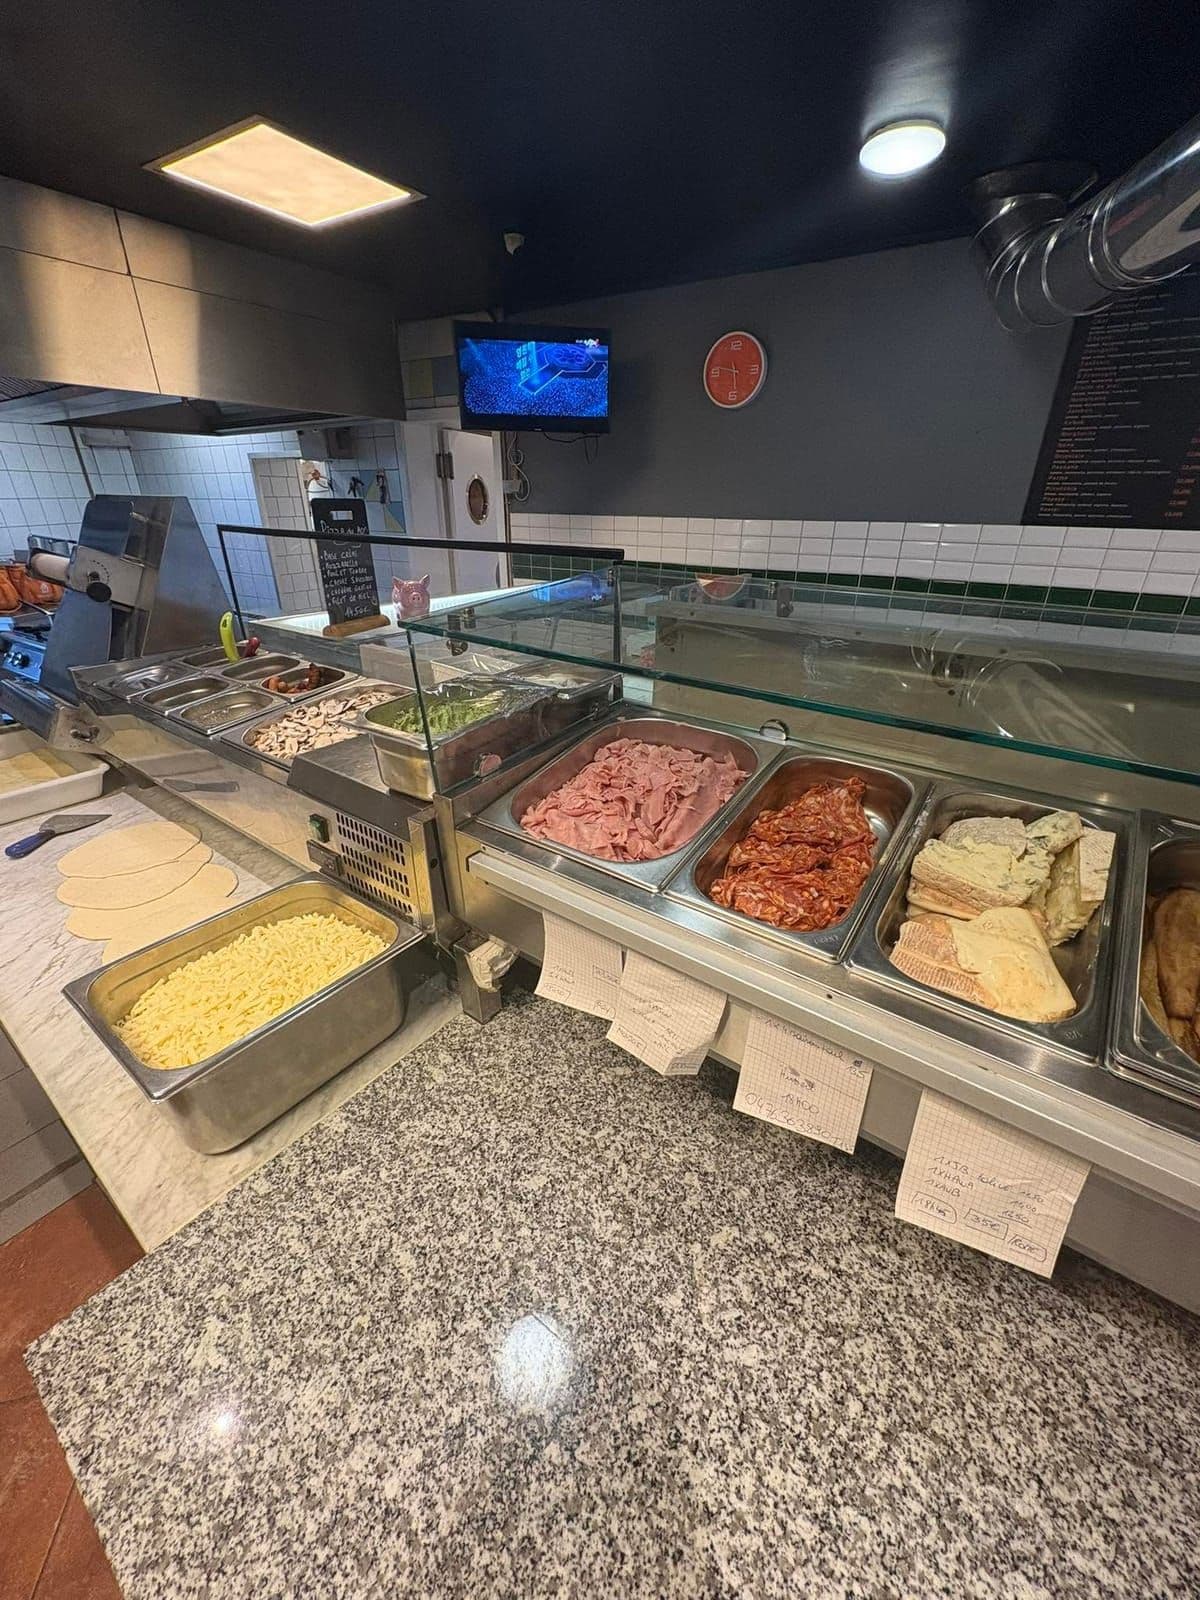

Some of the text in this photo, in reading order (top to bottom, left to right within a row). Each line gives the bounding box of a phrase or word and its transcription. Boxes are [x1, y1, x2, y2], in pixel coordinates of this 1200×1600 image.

[731, 340, 743, 351] 12
[711, 367, 720, 378] 9
[750, 364, 760, 375] 3
[728, 391, 738, 401] 6
